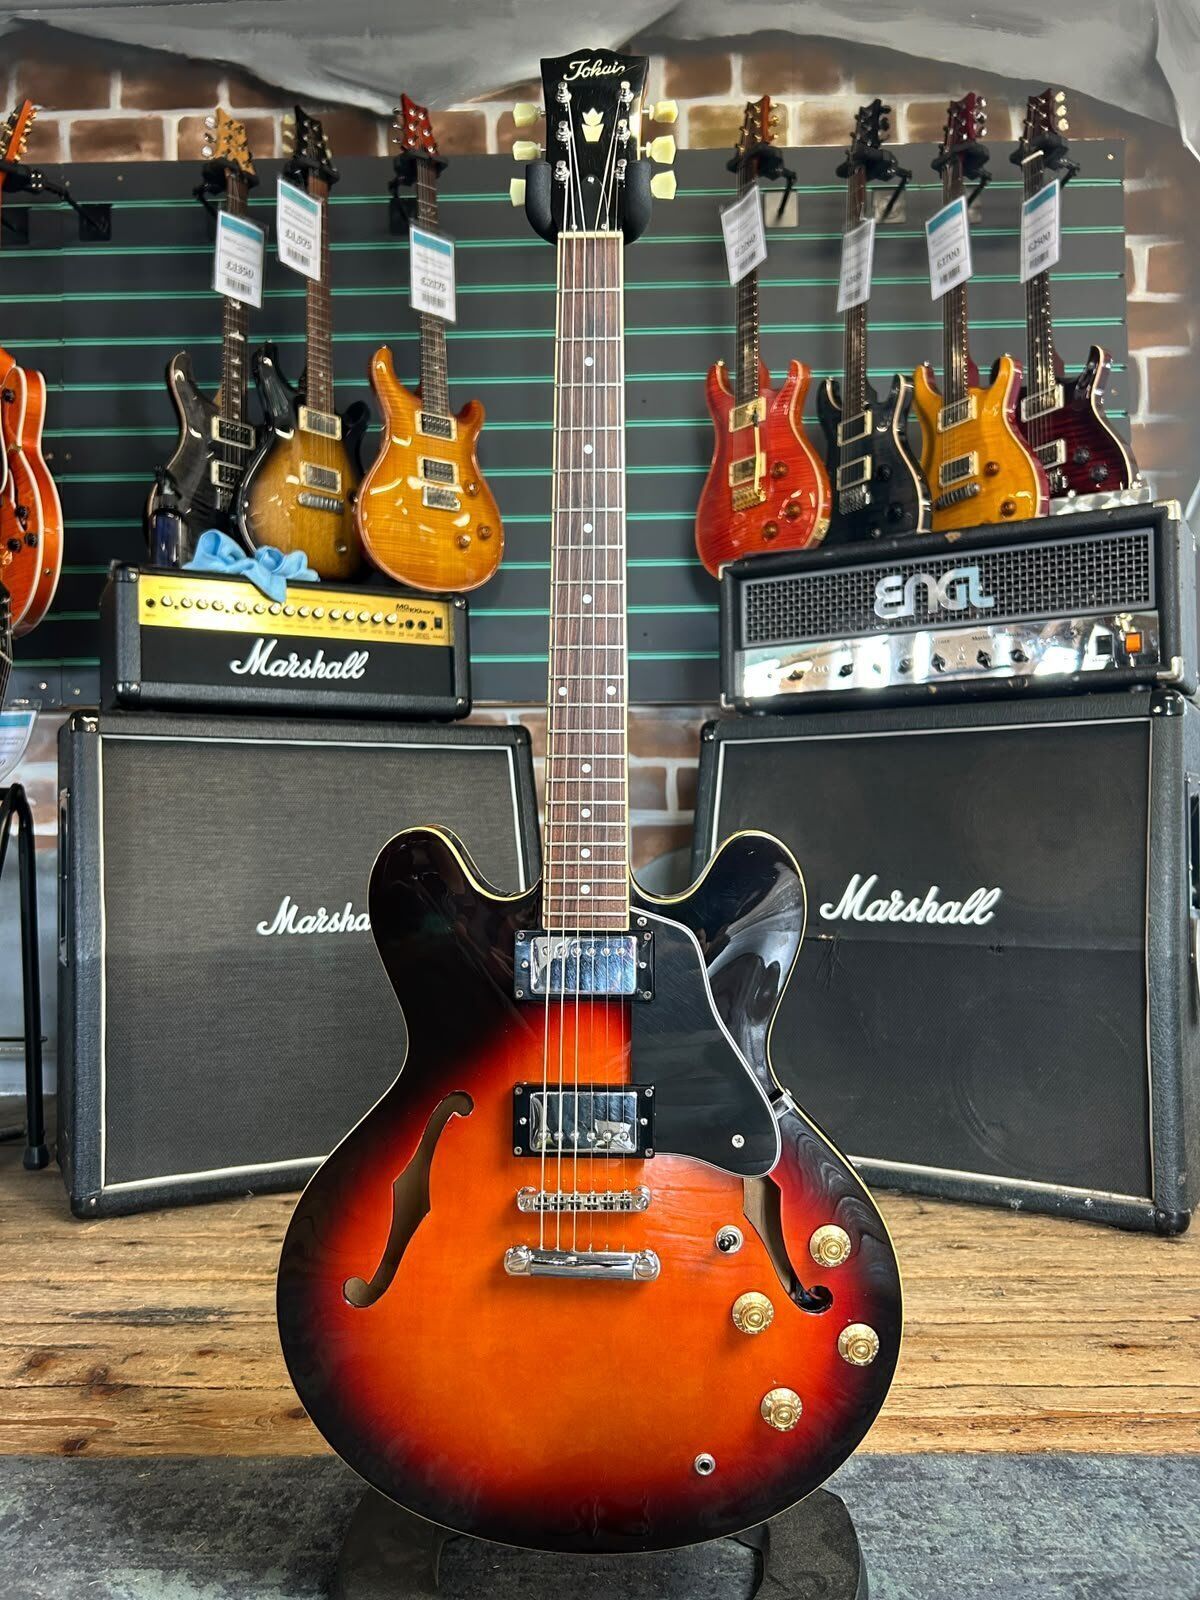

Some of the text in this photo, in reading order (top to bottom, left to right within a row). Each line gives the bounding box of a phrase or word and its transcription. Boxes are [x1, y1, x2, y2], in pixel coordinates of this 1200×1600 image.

[874, 565, 996, 620] ENGL
[229, 637, 370, 680] Marshall
[256, 895, 372, 936] Marsha
[819, 873, 1003, 926] Marshall
